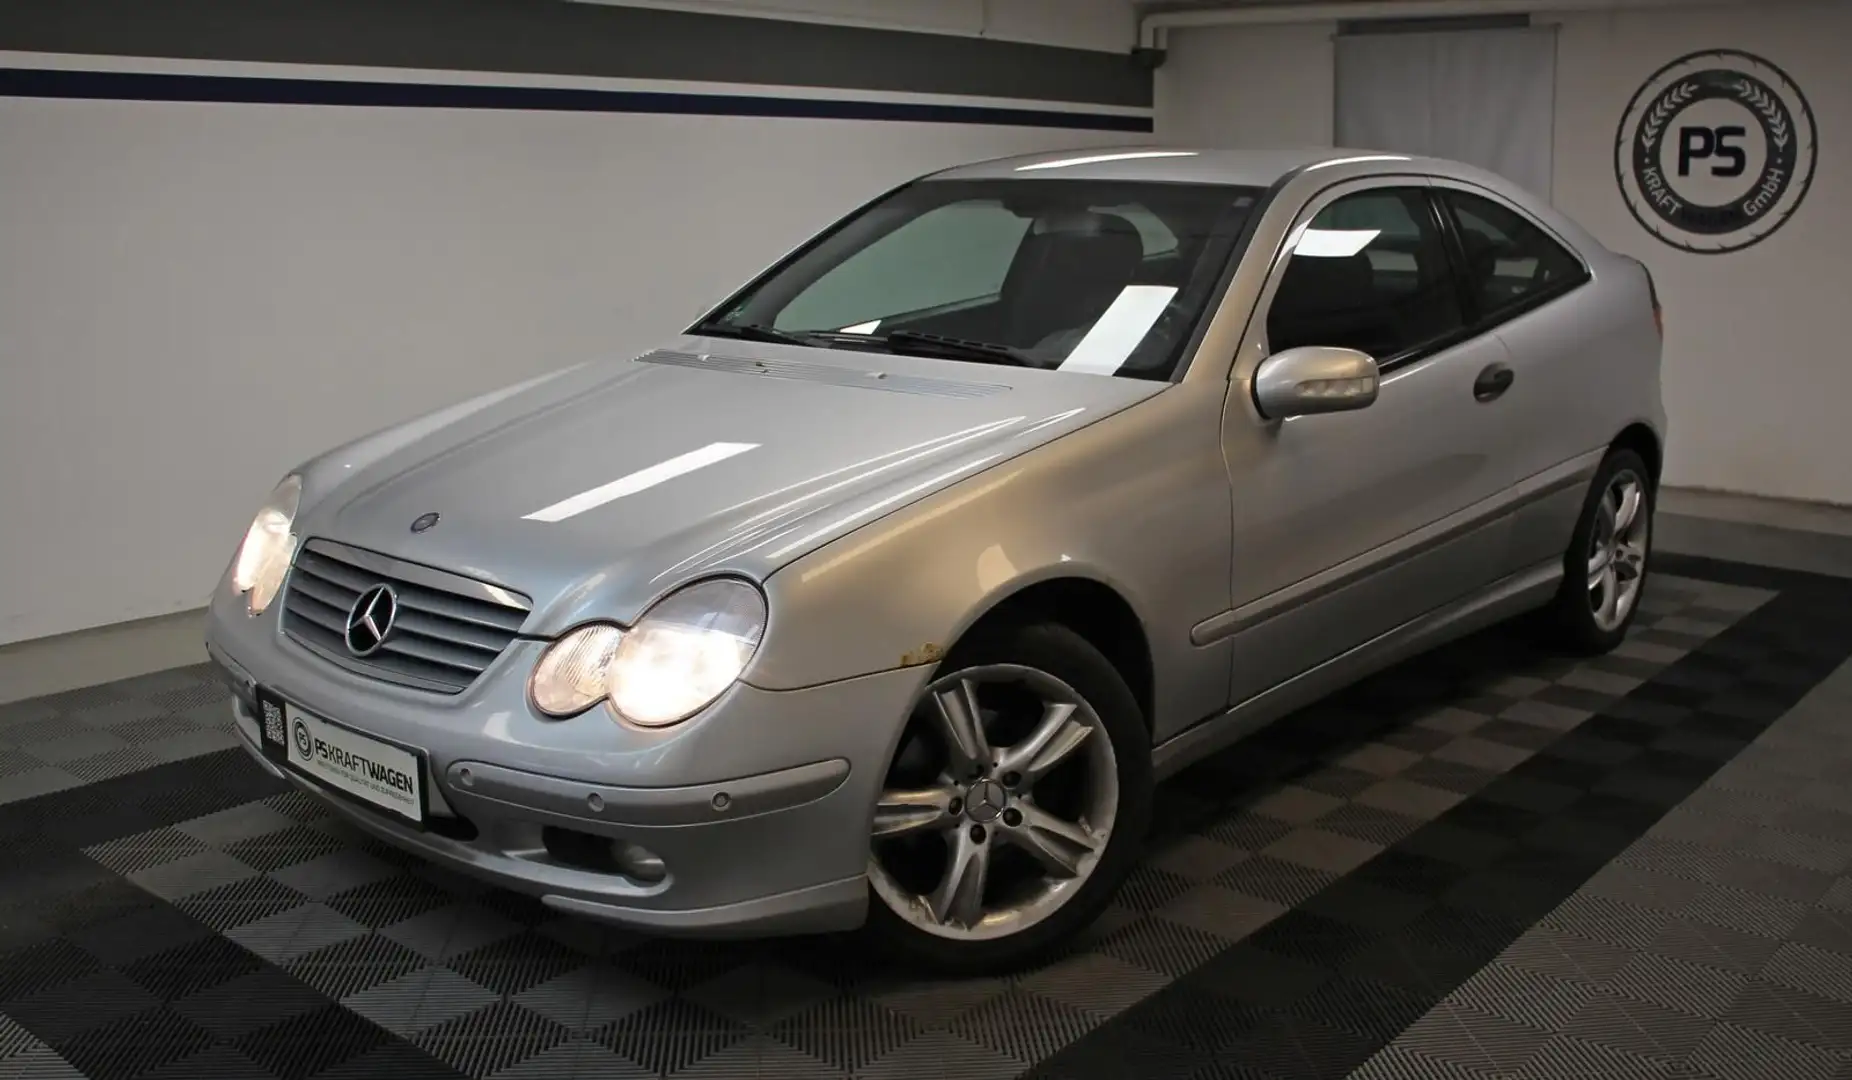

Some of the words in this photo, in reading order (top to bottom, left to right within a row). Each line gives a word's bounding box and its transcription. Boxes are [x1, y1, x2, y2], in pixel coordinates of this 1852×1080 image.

[1678, 127, 1746, 177] PS
[1642, 167, 1684, 216] KRAFT
[1743, 168, 1785, 217] GmbH
